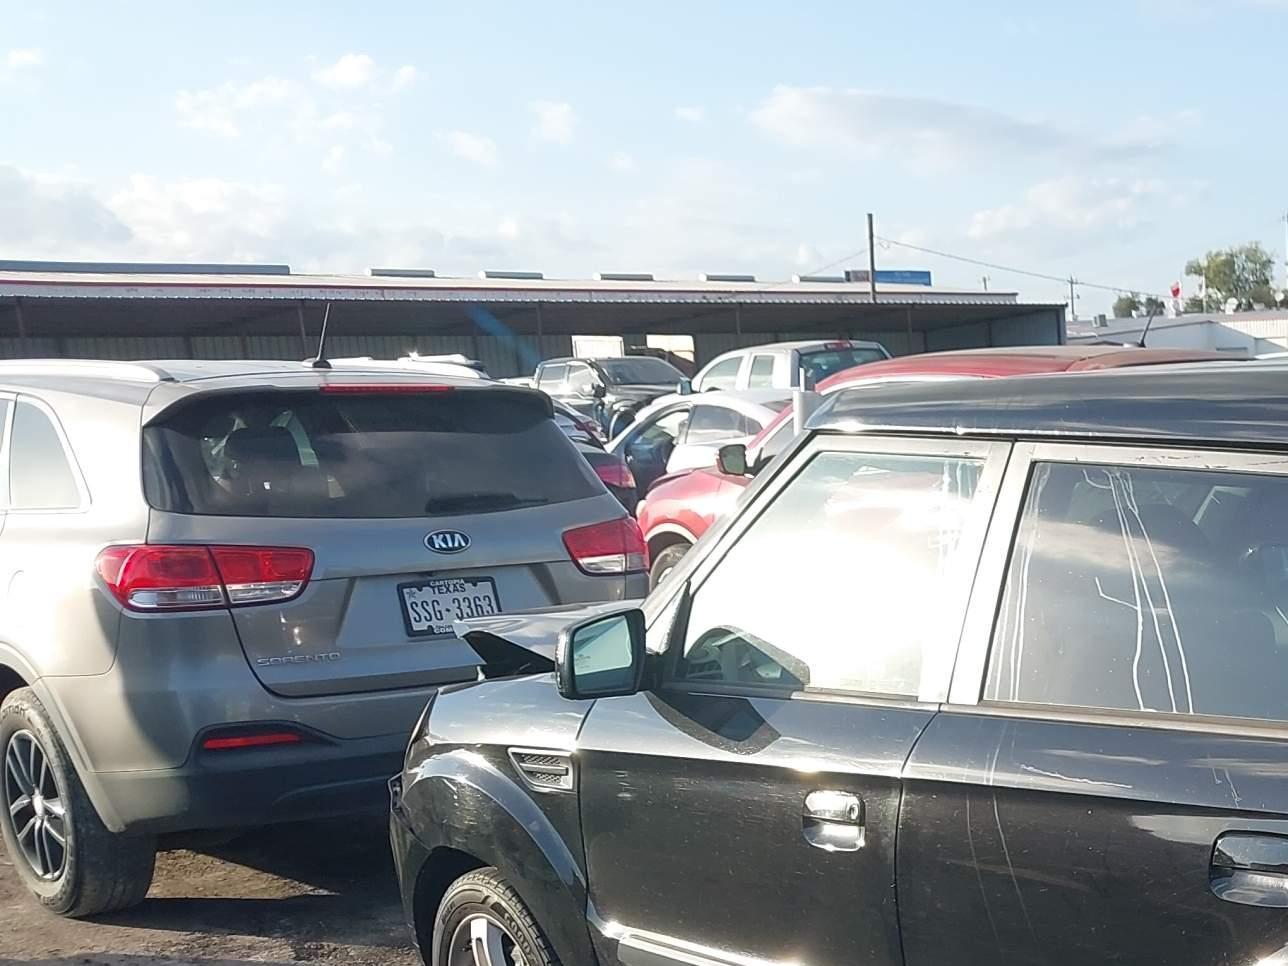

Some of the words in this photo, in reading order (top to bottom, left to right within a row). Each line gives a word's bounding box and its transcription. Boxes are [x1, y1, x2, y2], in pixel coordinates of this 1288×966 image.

[432, 533, 466, 549] KIA
[430, 583, 466, 595] TEXAS
[257, 652, 340, 666] SORENTO
